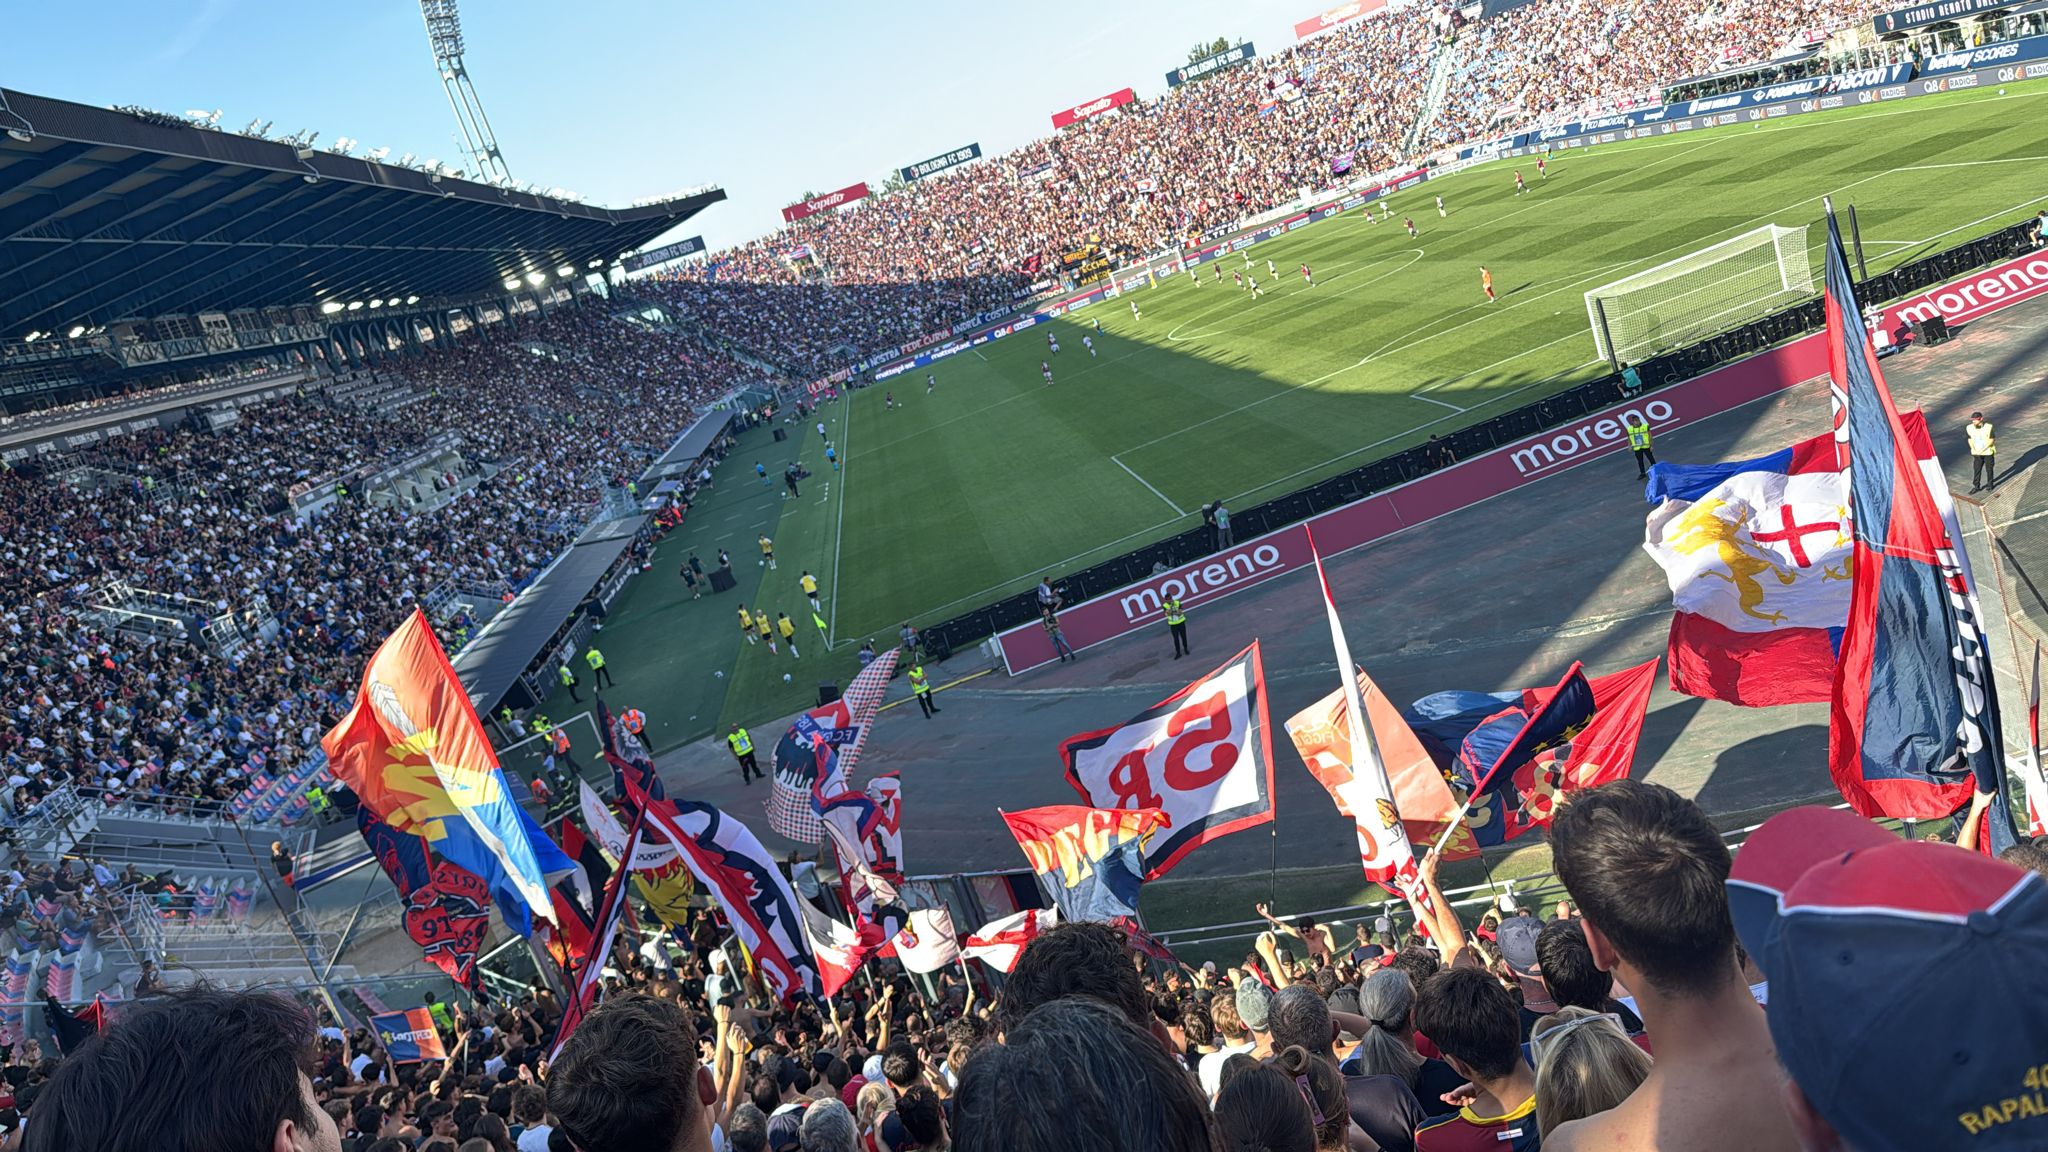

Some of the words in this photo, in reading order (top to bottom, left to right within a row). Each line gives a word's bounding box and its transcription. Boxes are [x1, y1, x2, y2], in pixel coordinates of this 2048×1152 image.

[1905, 8, 1935, 24] STADIO
[1938, 0, 1972, 17] RENATO
[1187, 56, 1218, 78] BOLOGNA
[1217, 52, 1228, 69] FC
[1928, 51, 1974, 71] betway
[1973, 44, 2019, 62] SCORES
[1997, 66, 2014, 82] Q8
[1923, 80, 1939, 94] Q8
[1950, 77, 1971, 88] RADIO
[1858, 89, 1872, 103] Q8
[1881, 87, 1900, 98] RADIO
[1073, 97, 1112, 119] Saputo
[1801, 100, 1813, 112] Q8
[1821, 97, 1839, 107] RADIO
[1702, 117, 1713, 127] Q8
[1749, 108, 1760, 120] Q8
[918, 156, 948, 175] BOLOGNA
[947, 153, 958, 166] FC
[956, 147, 973, 162] 1909
[1379, 185, 1391, 197] Q8
[806, 192, 845, 213] Saputo
[1324, 206, 1336, 217] Q8
[1200, 224, 1240, 244] ULTRAS
[1269, 227, 1281, 238] Q8
[642, 248, 670, 266] BOLOGNA
[669, 244, 680, 258] FC
[679, 240, 695, 255] 1909
[1214, 247, 1226, 258] Q8
[1159, 267, 1171, 278] Q8
[1896, 260, 2048, 322] moreno
[1049, 308, 1061, 318] Q8
[869, 348, 900, 367] NOSTRA
[900, 338, 922, 355] FEDE
[923, 329, 951, 345] CURVA
[952, 317, 982, 335] ANDREA
[984, 304, 1011, 322] COSTA
[994, 328, 1007, 339] Q8
[1510, 400, 1673, 473] moreno
[1120, 544, 1280, 619] moreno
